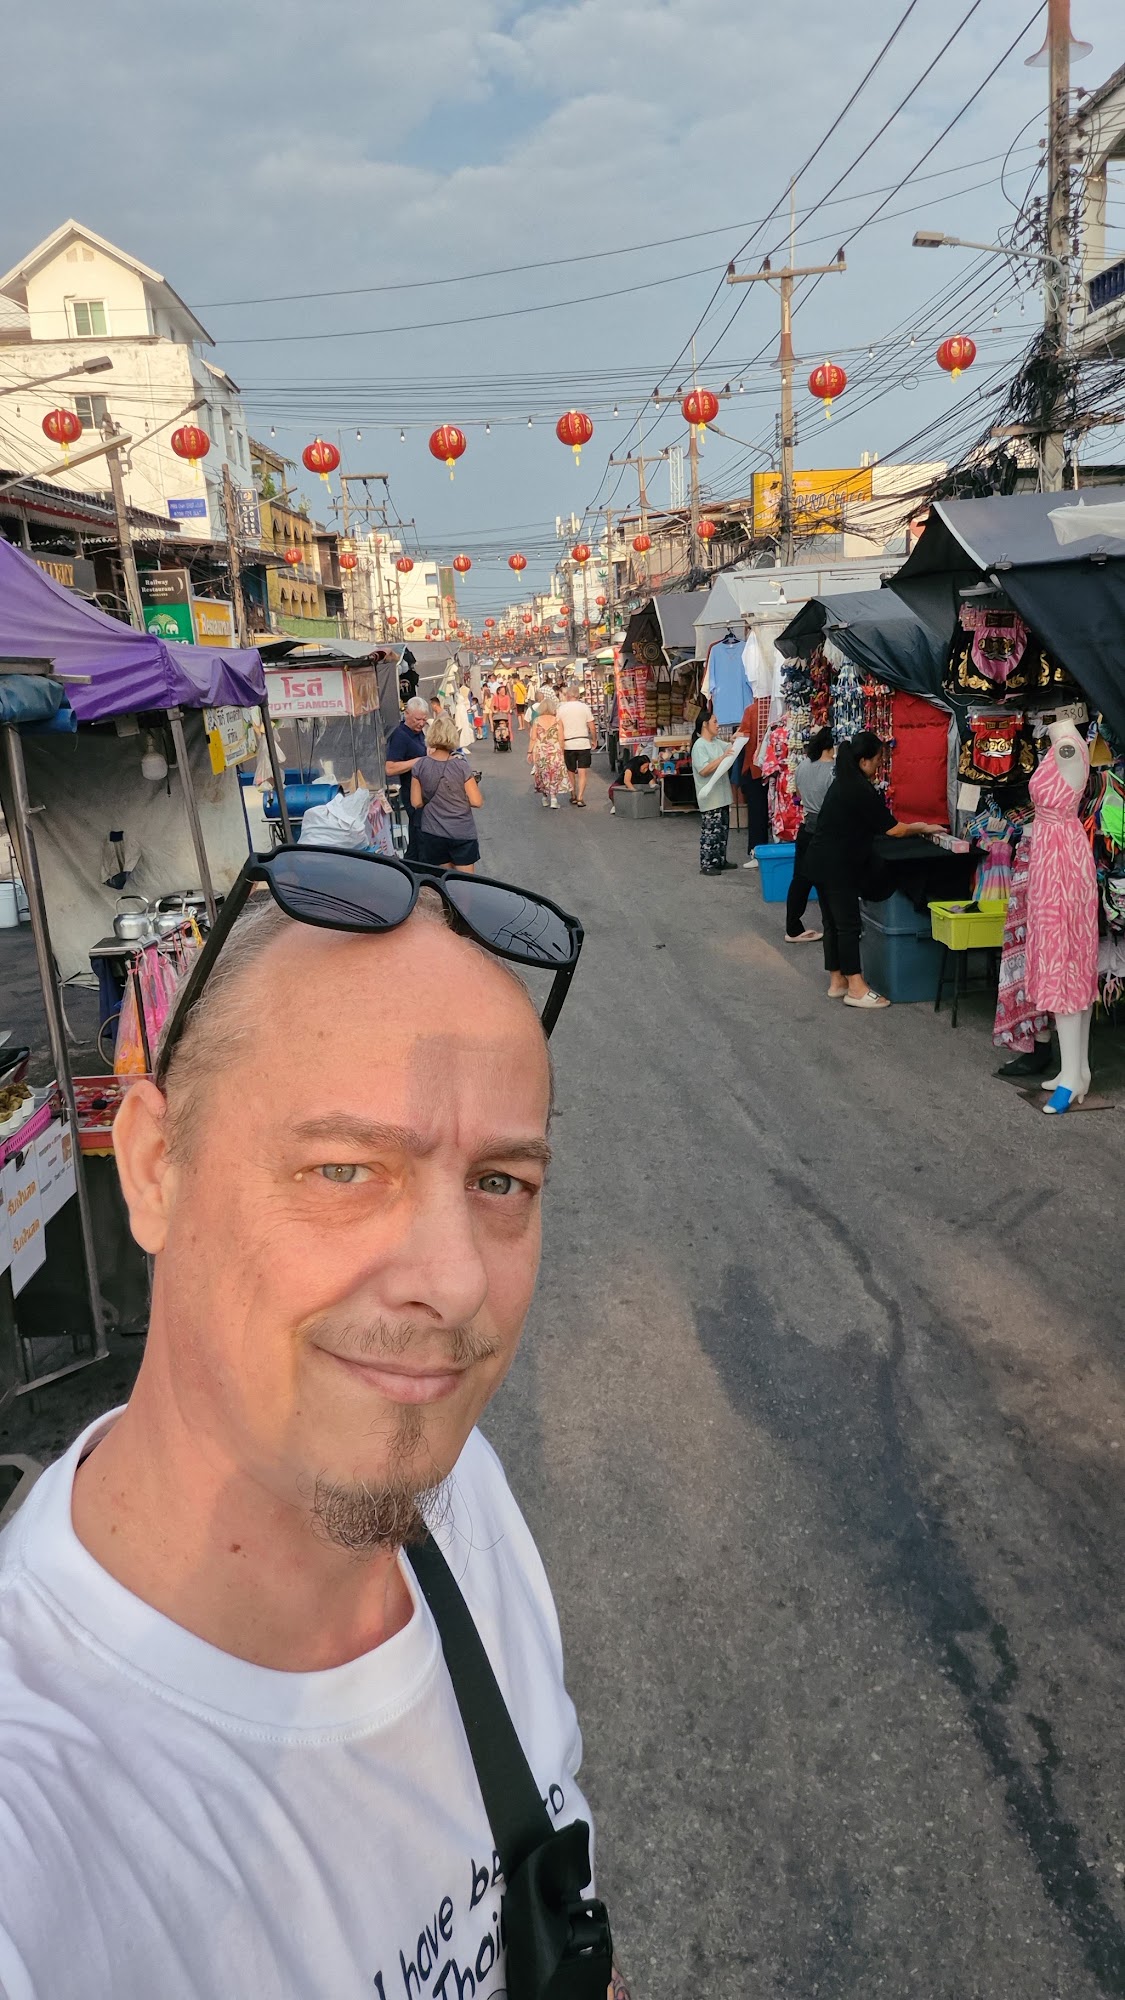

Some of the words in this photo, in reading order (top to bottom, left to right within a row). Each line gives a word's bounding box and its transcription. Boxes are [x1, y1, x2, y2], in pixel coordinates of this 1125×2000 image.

[297, 699, 343, 710] SAMOSA
[1061, 706, 1084, 720] 380
[399, 1896, 453, 2000] have
